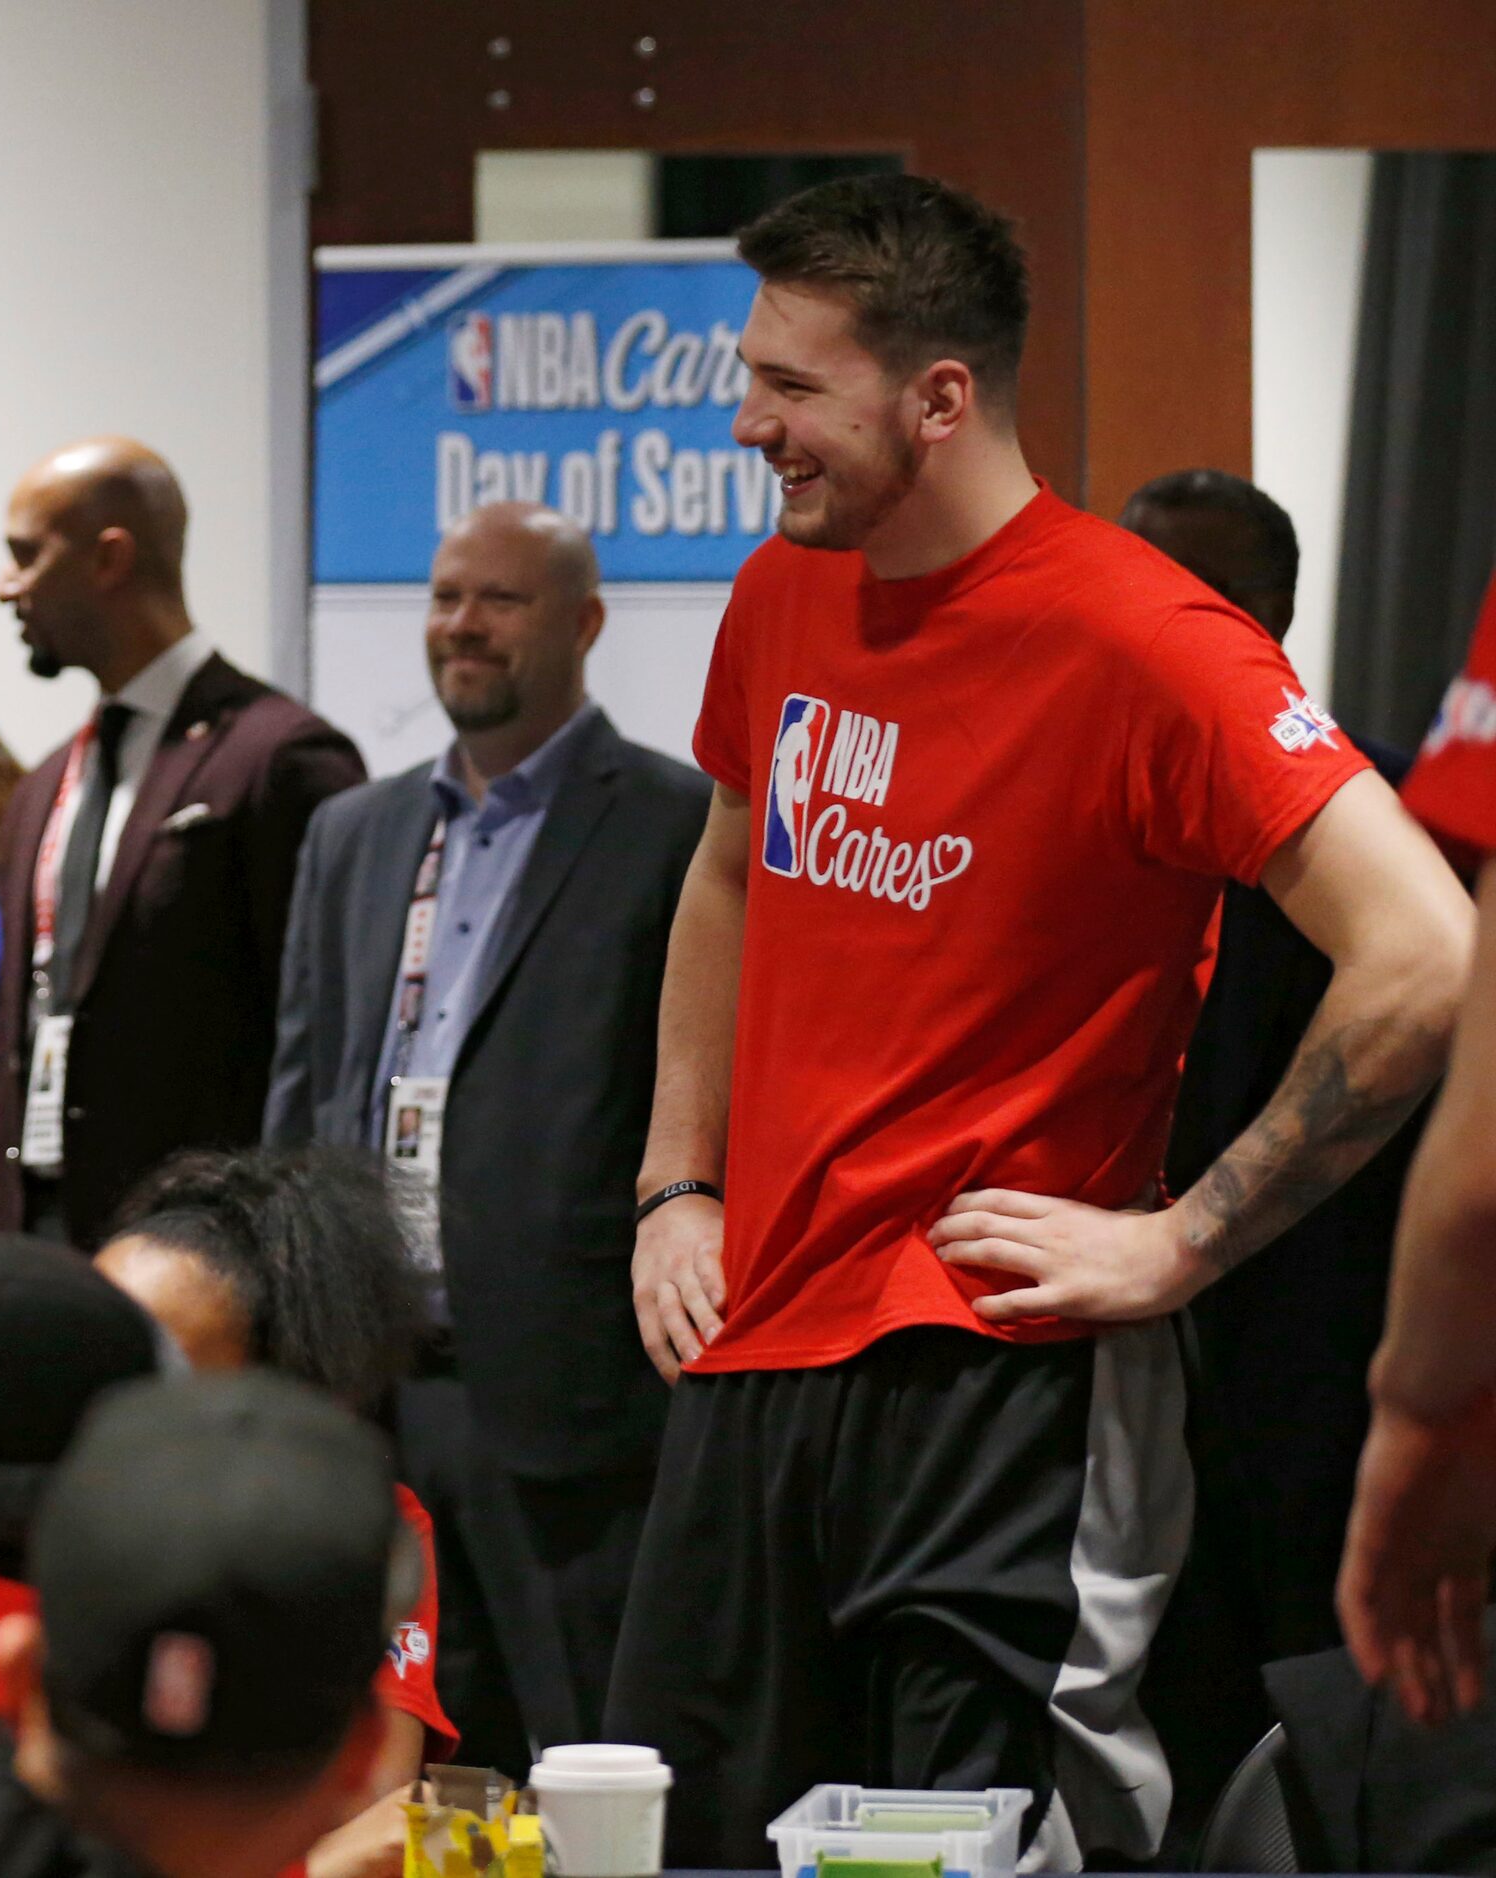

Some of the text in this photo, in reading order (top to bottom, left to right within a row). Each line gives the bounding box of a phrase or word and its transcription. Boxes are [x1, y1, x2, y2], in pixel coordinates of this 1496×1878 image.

[497, 311, 601, 410] NBA
[559, 428, 620, 536] of
[821, 709, 900, 807] NBA
[806, 803, 972, 912] Cares
